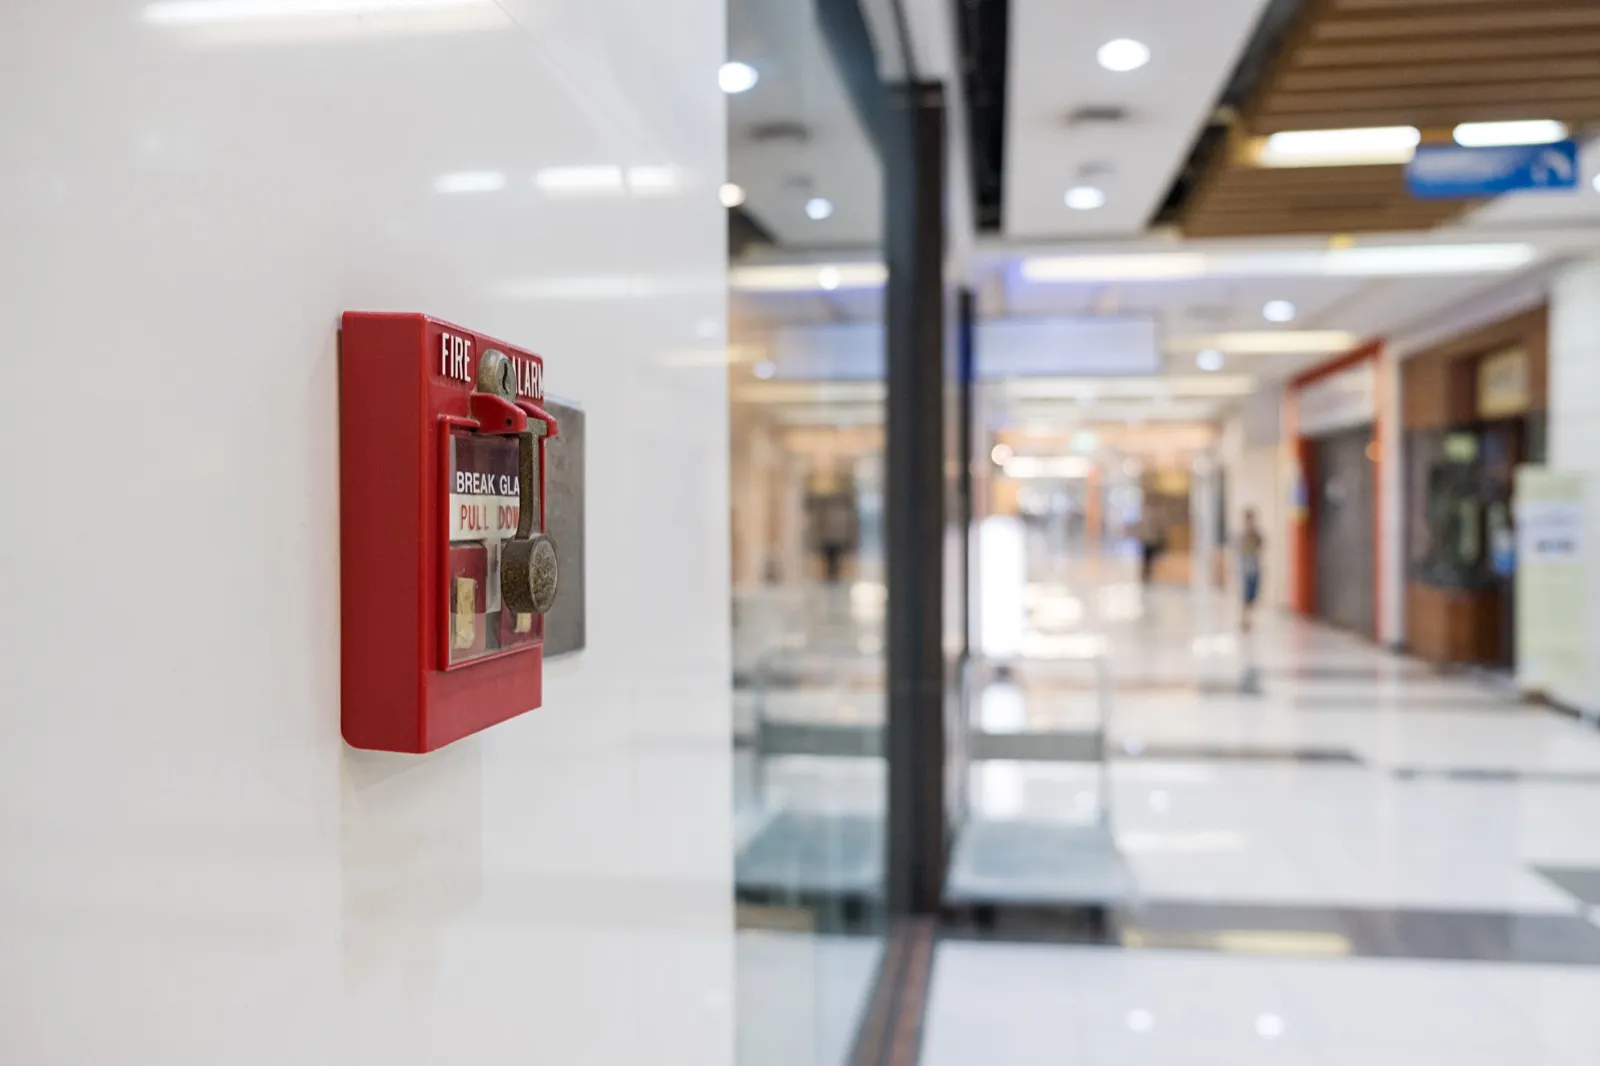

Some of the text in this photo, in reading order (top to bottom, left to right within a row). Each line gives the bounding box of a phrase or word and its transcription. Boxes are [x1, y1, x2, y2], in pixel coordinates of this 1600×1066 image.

[441, 332, 471, 382] FIRE
[456, 471, 520, 496] BREAK GLA
[460, 504, 519, 530] PULL DOW
